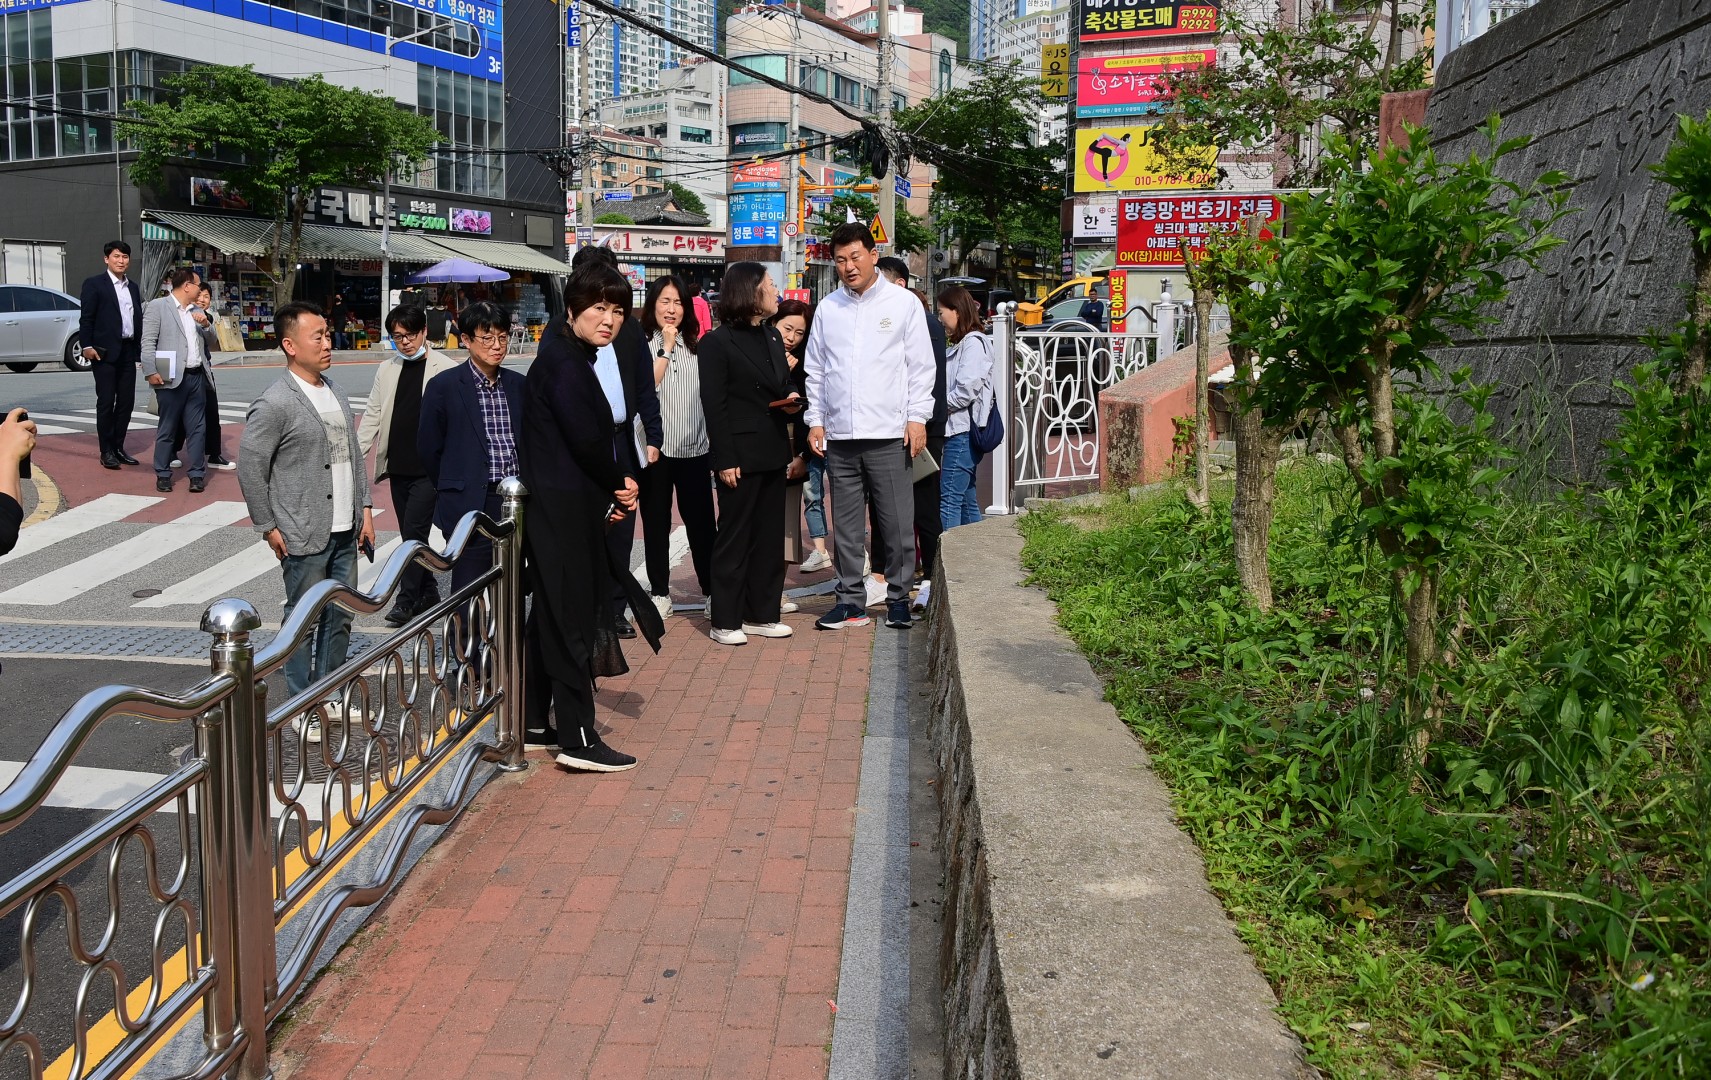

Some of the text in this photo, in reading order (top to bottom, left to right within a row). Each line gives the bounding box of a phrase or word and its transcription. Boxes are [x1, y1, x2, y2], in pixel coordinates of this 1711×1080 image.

[448, 0, 495, 26] 영유아 검진
[1084, 6, 1173, 32] 축산물도매
[1191, 8, 1214, 19] 994
[1180, 19, 1210, 30] 9292
[1054, 48, 1067, 58] JS
[488, 55, 501, 74] 3F
[745, 166, 778, 176] 삼성영어
[728, 195, 745, 204] 영어는
[732, 203, 773, 212] 공부가 아니고
[400, 213, 447, 230] 545-2000
[733, 225, 777, 240] 정문약국
[673, 235, 719, 253] 대박
[1119, 250, 1183, 264] OK(잡)서비스
